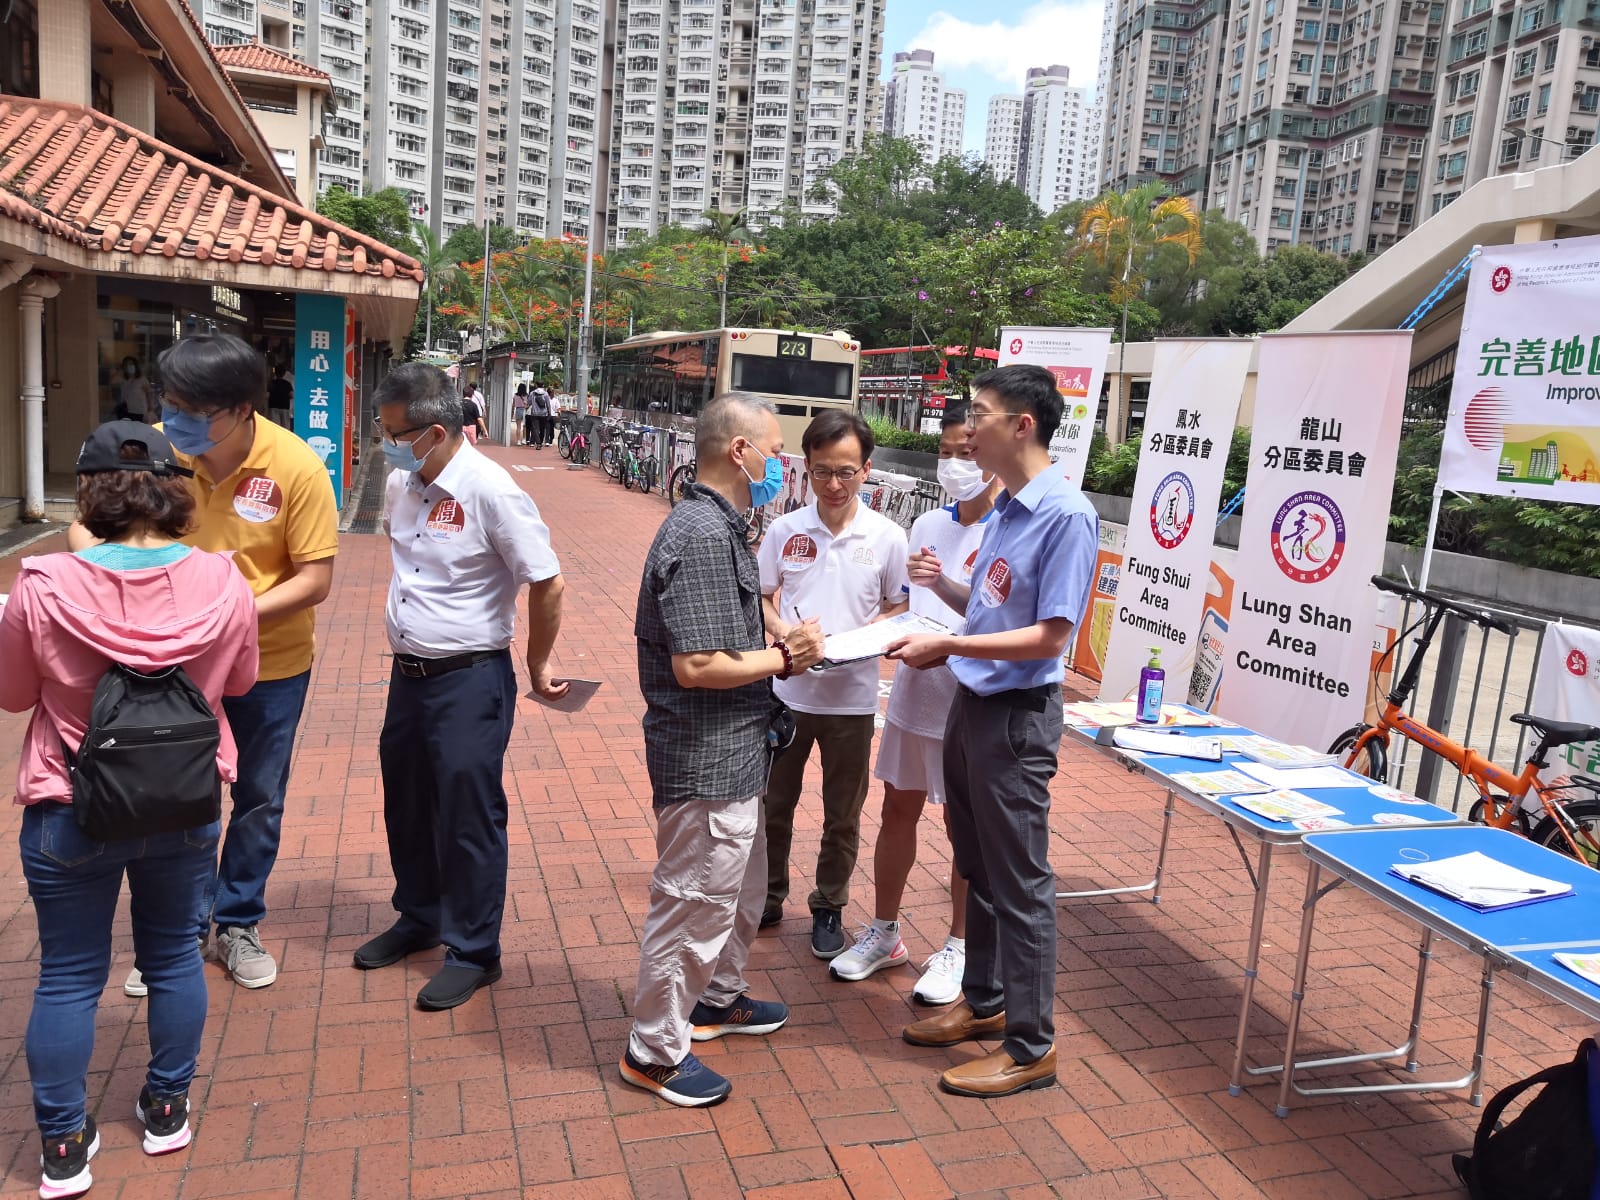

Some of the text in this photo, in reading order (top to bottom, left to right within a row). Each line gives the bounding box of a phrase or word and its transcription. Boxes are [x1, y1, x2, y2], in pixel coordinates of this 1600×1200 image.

[781, 340, 807, 357] 273
[1175, 408, 1202, 430] 鳳水
[1300, 416, 1342, 443] 龍山
[1150, 432, 1214, 460] 分區委員會
[1264, 445, 1367, 478] 分區委員會
[1304, 494, 1321, 502] AREA
[1321, 498, 1343, 533] COMMITTEE
[1128, 557, 1161, 584] Fung
[1162, 567, 1191, 591] Shui
[1140, 587, 1169, 611] Area
[1241, 592, 1352, 634] Lung Shan
[1119, 606, 1187, 645] Committee
[1266, 628, 1317, 657] Area
[1236, 650, 1350, 698] Committee
